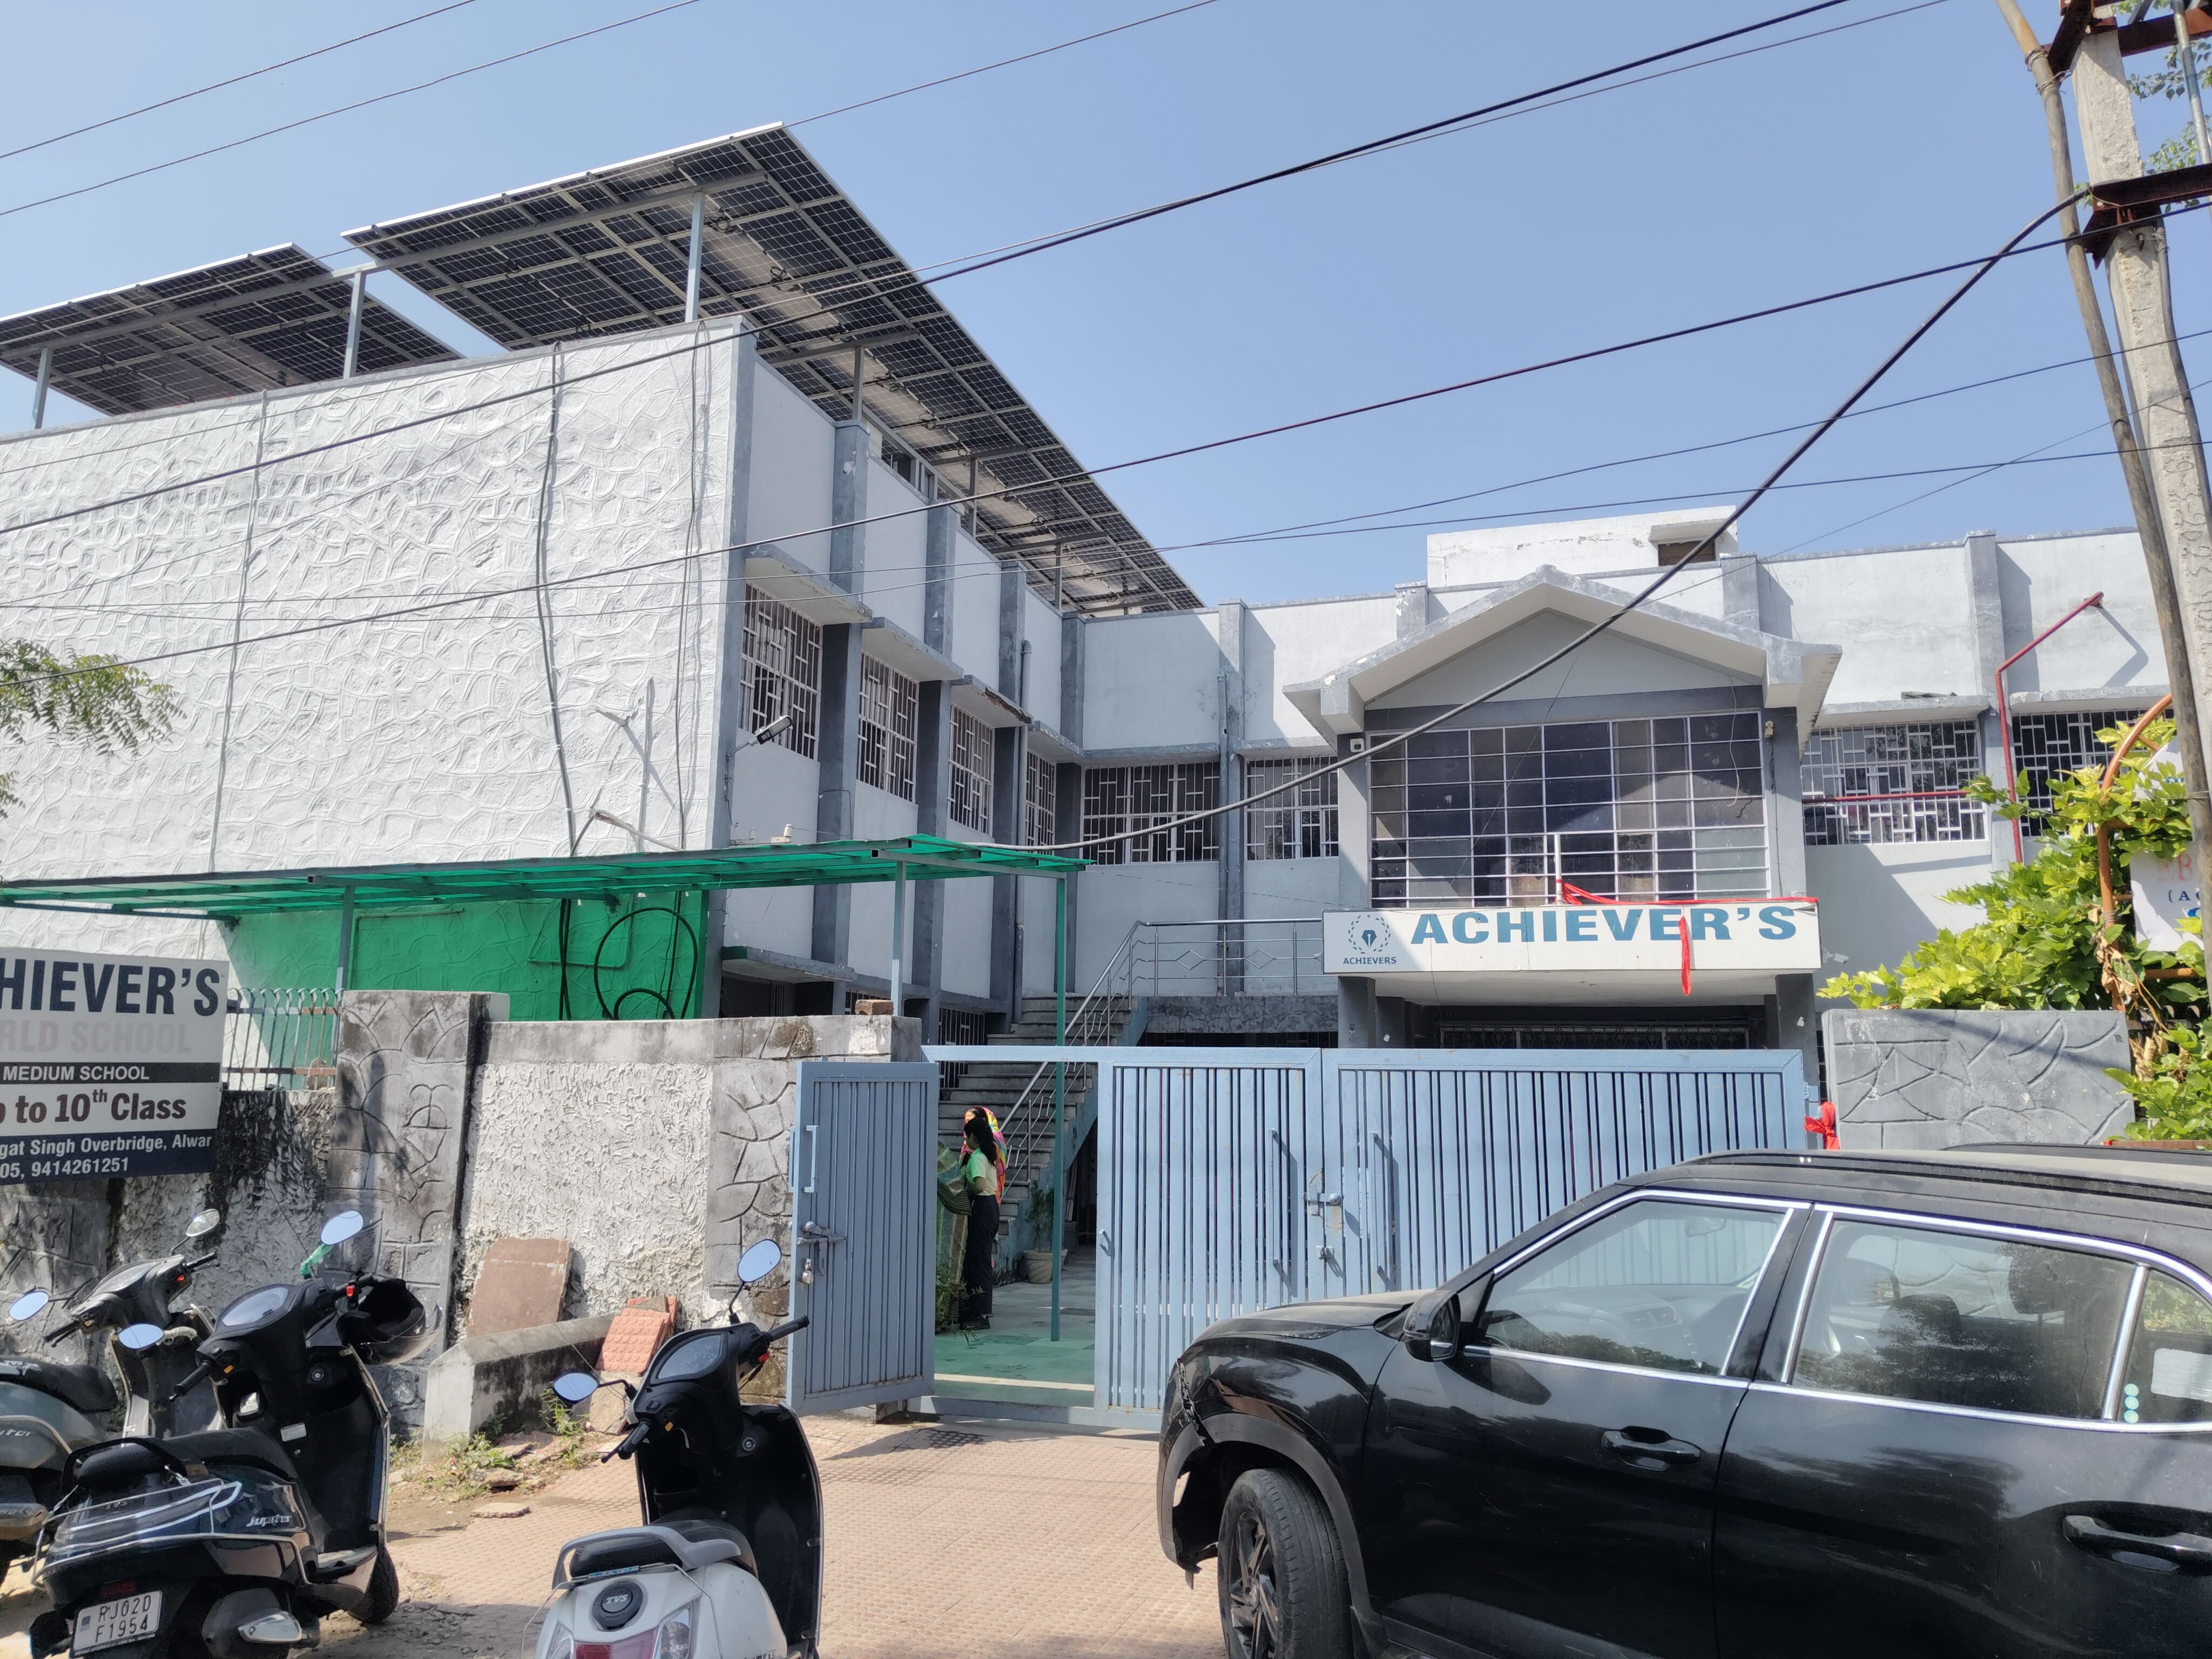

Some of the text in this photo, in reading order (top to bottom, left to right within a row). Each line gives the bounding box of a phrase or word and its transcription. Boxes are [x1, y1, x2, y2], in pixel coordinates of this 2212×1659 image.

[1411, 906, 1797, 945] ACHIEVER'S
[1343, 955, 1398, 965] ACHIEVERS
[71, 1021, 191, 1053] SCHOOL
[3, 1065, 150, 1081] MEDIUM SCHOOL
[15, 1095, 47, 1123] to
[55, 1089, 107, 1122] 10th
[111, 1093, 186, 1121] Class
[30, 1137, 75, 1157] Singh
[80, 1135, 167, 1153] Overbridge,
[172, 1134, 212, 1149] Alwar
[31, 1158, 129, 1177] 9414261251
[98, 1595, 152, 1623] RJ02D
[605, 1594, 629, 1604] TVS
[95, 1614, 149, 1643] F1954
